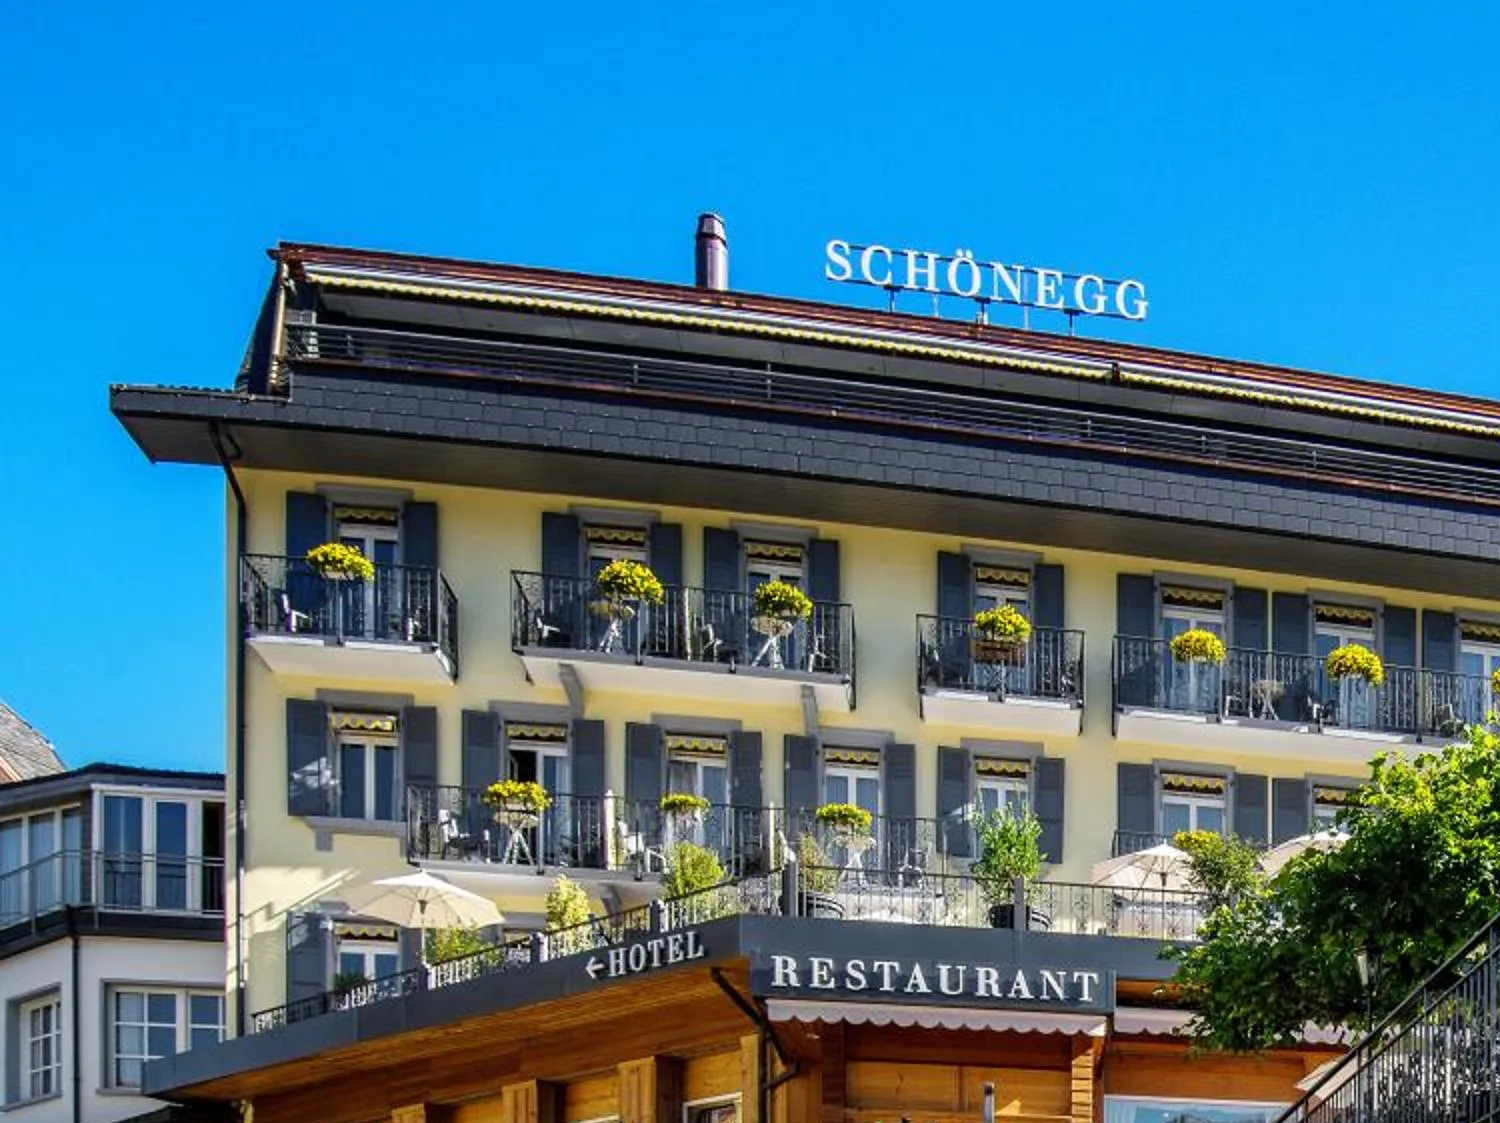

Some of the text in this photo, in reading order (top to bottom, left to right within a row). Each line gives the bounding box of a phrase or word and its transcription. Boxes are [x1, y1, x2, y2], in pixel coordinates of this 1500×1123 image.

[825, 240, 1148, 319] SCHÖNEGG
[608, 931, 704, 977] HOTEL
[771, 955, 1099, 1002] RESTAURANT
